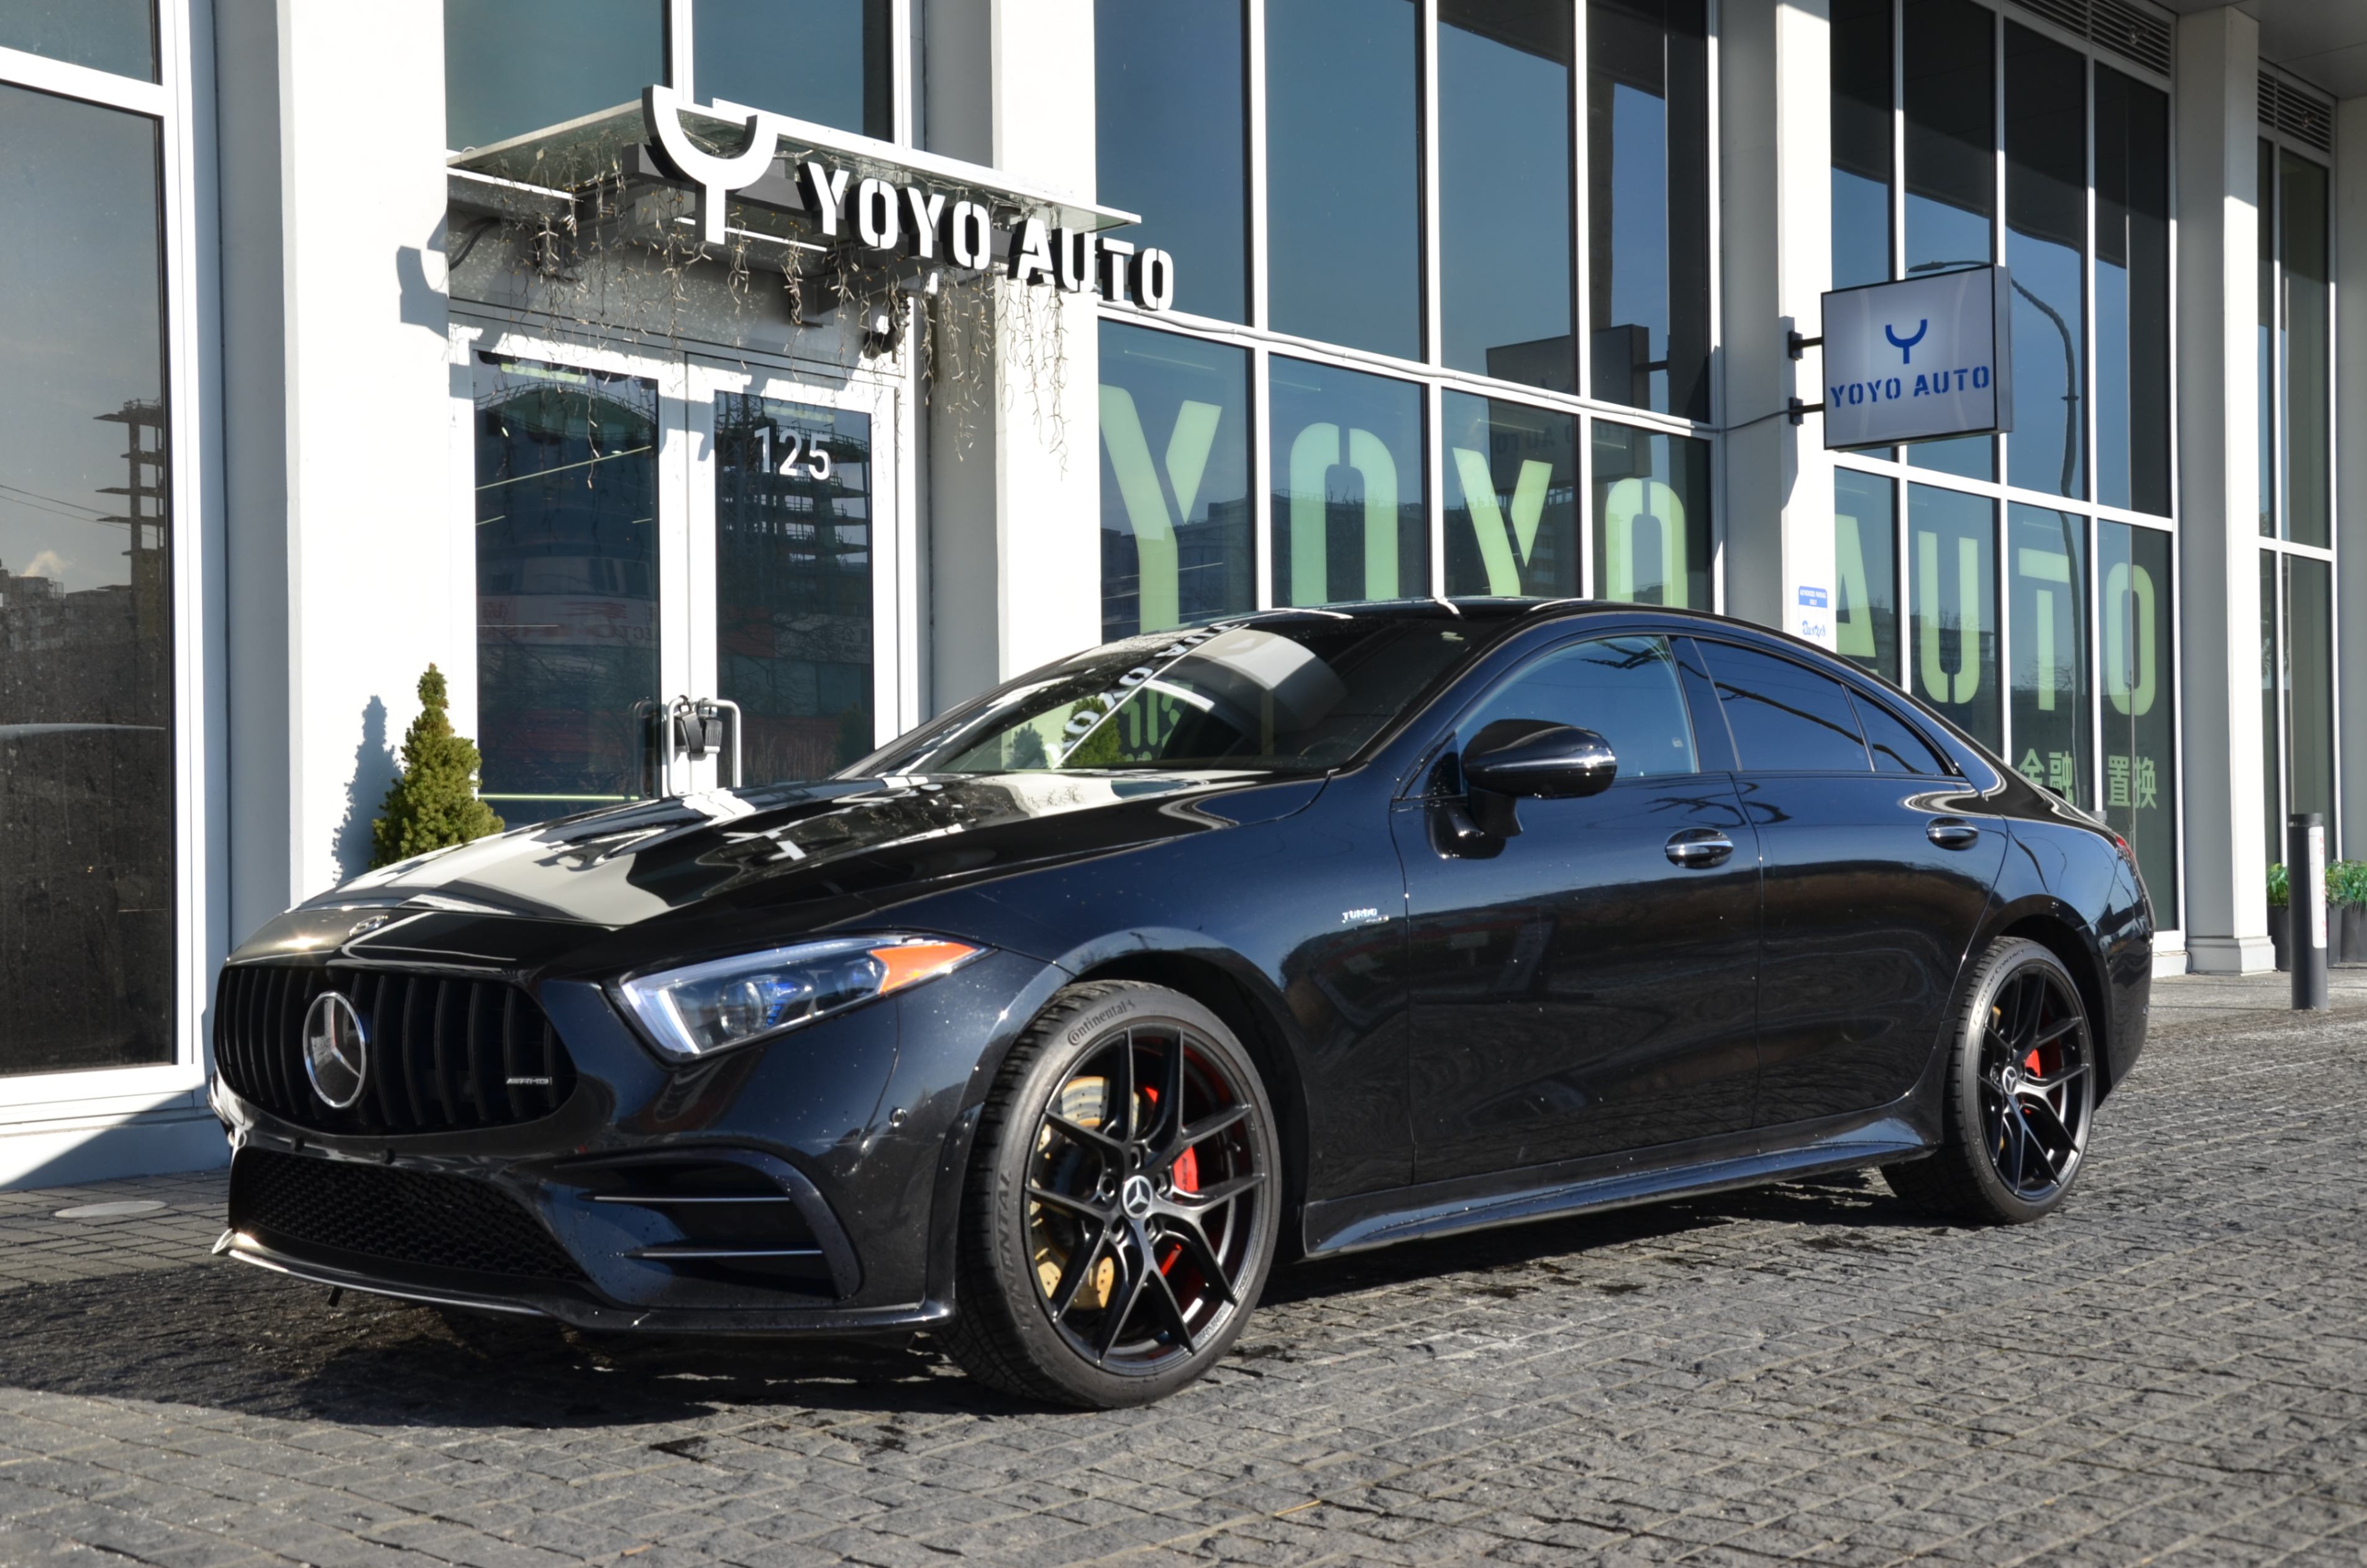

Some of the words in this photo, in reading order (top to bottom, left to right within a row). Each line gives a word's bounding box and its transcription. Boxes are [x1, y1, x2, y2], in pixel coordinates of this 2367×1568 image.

[801, 162, 990, 270] YOYO
[1013, 218, 1174, 311] AUTO
[1830, 378, 1901, 408] YOYO
[1913, 366, 1989, 397] AUTO
[754, 426, 831, 480] 125
[2018, 748, 2074, 805] 金融
[2108, 755, 2157, 809] 置换
[1067, 1001, 1126, 1046] Continental
